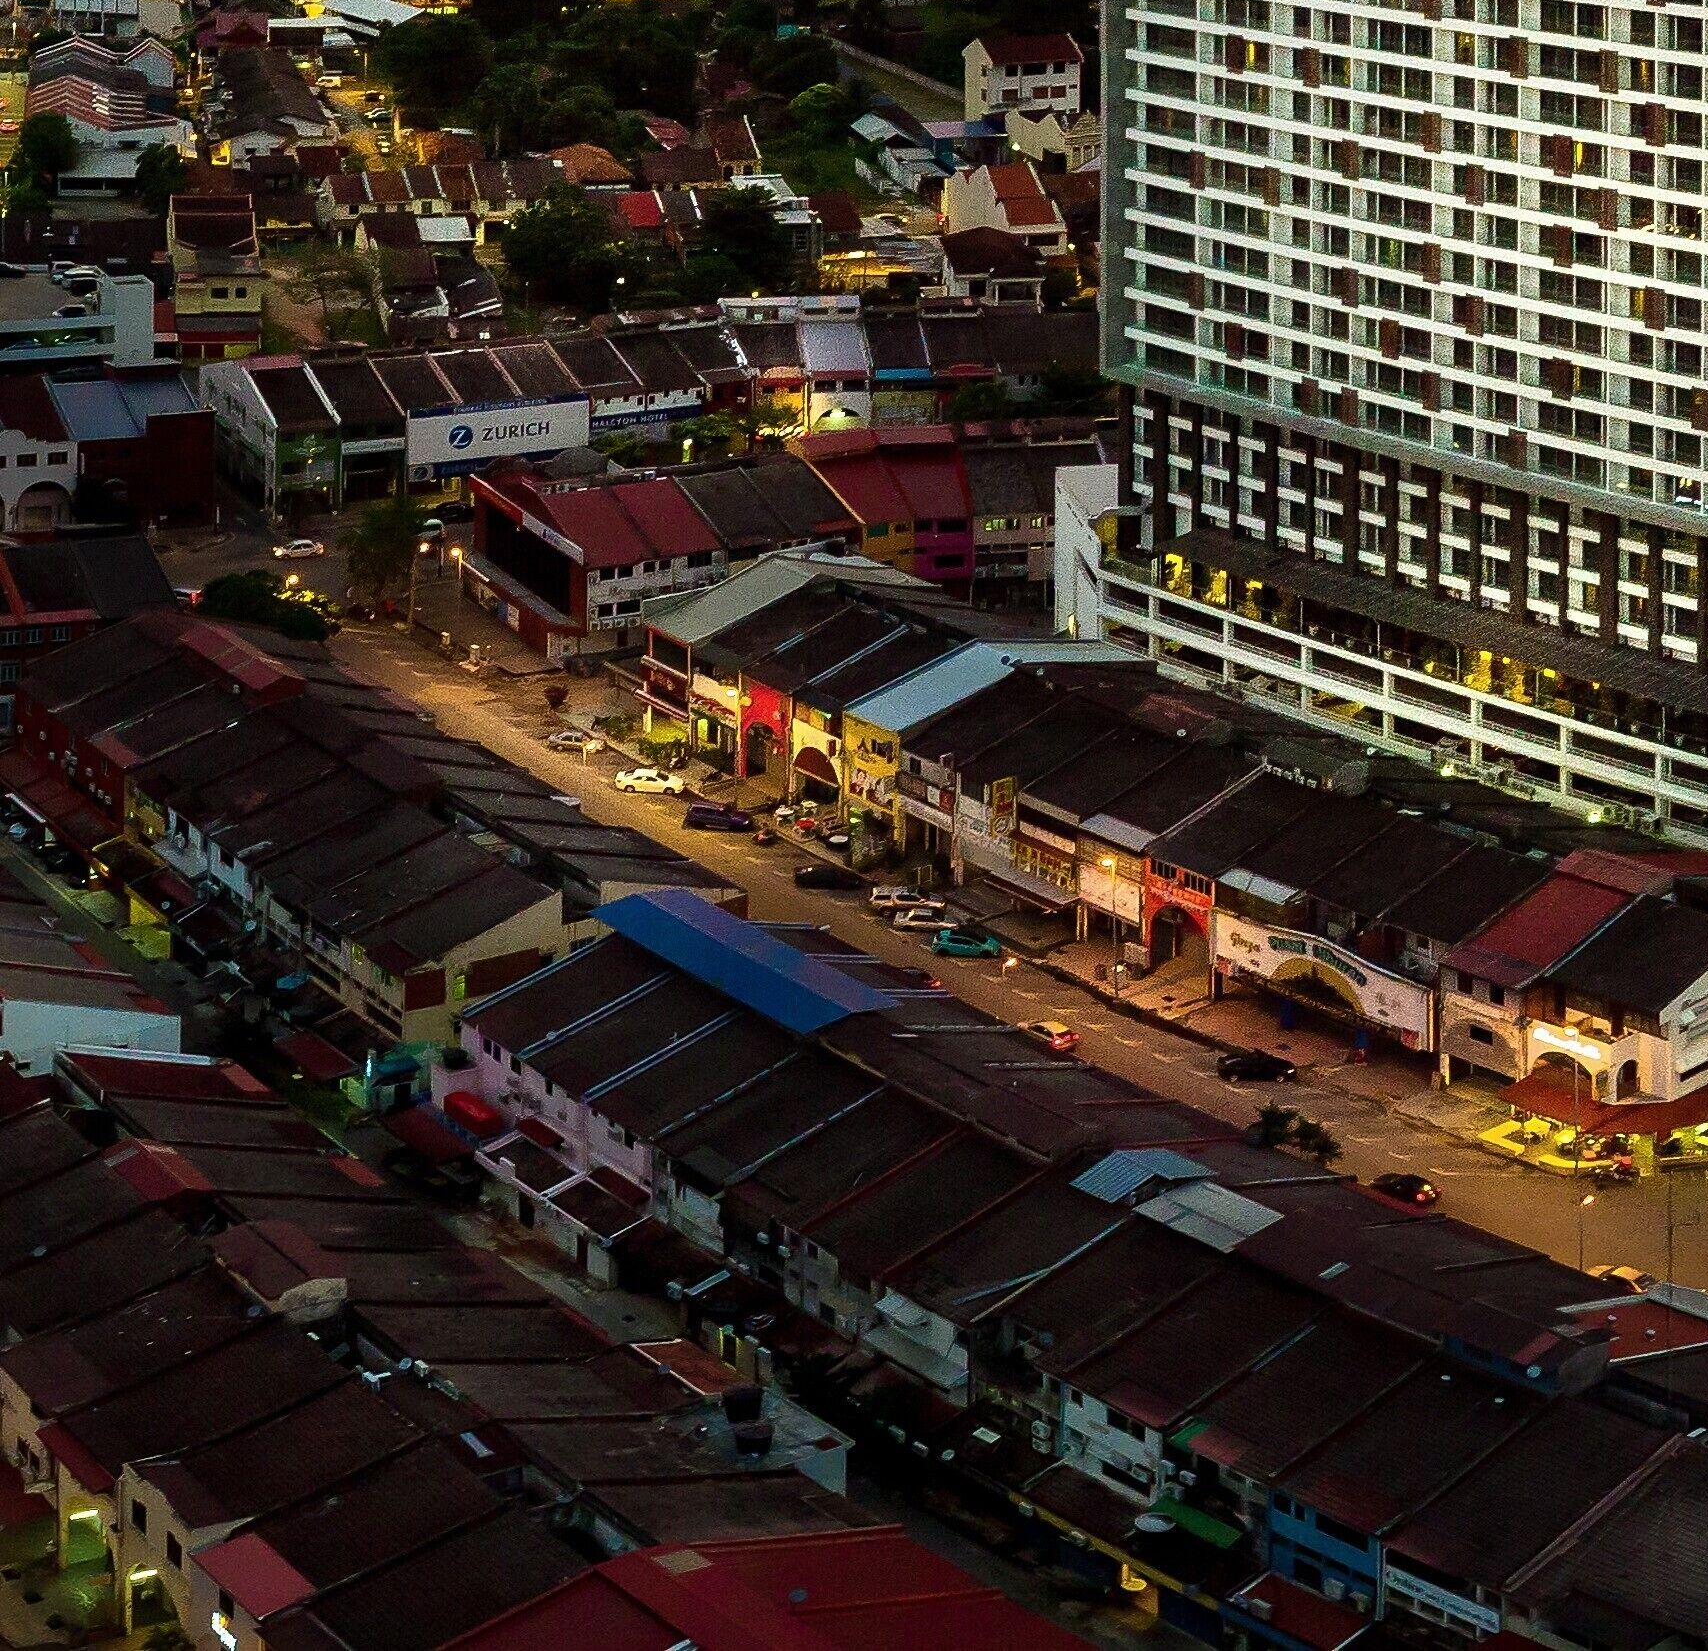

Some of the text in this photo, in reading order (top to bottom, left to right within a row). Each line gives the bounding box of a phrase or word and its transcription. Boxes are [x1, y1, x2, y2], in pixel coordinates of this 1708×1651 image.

[593, 413, 668, 428] HALCYON HOTEL
[482, 421, 550, 441] ZURICH
